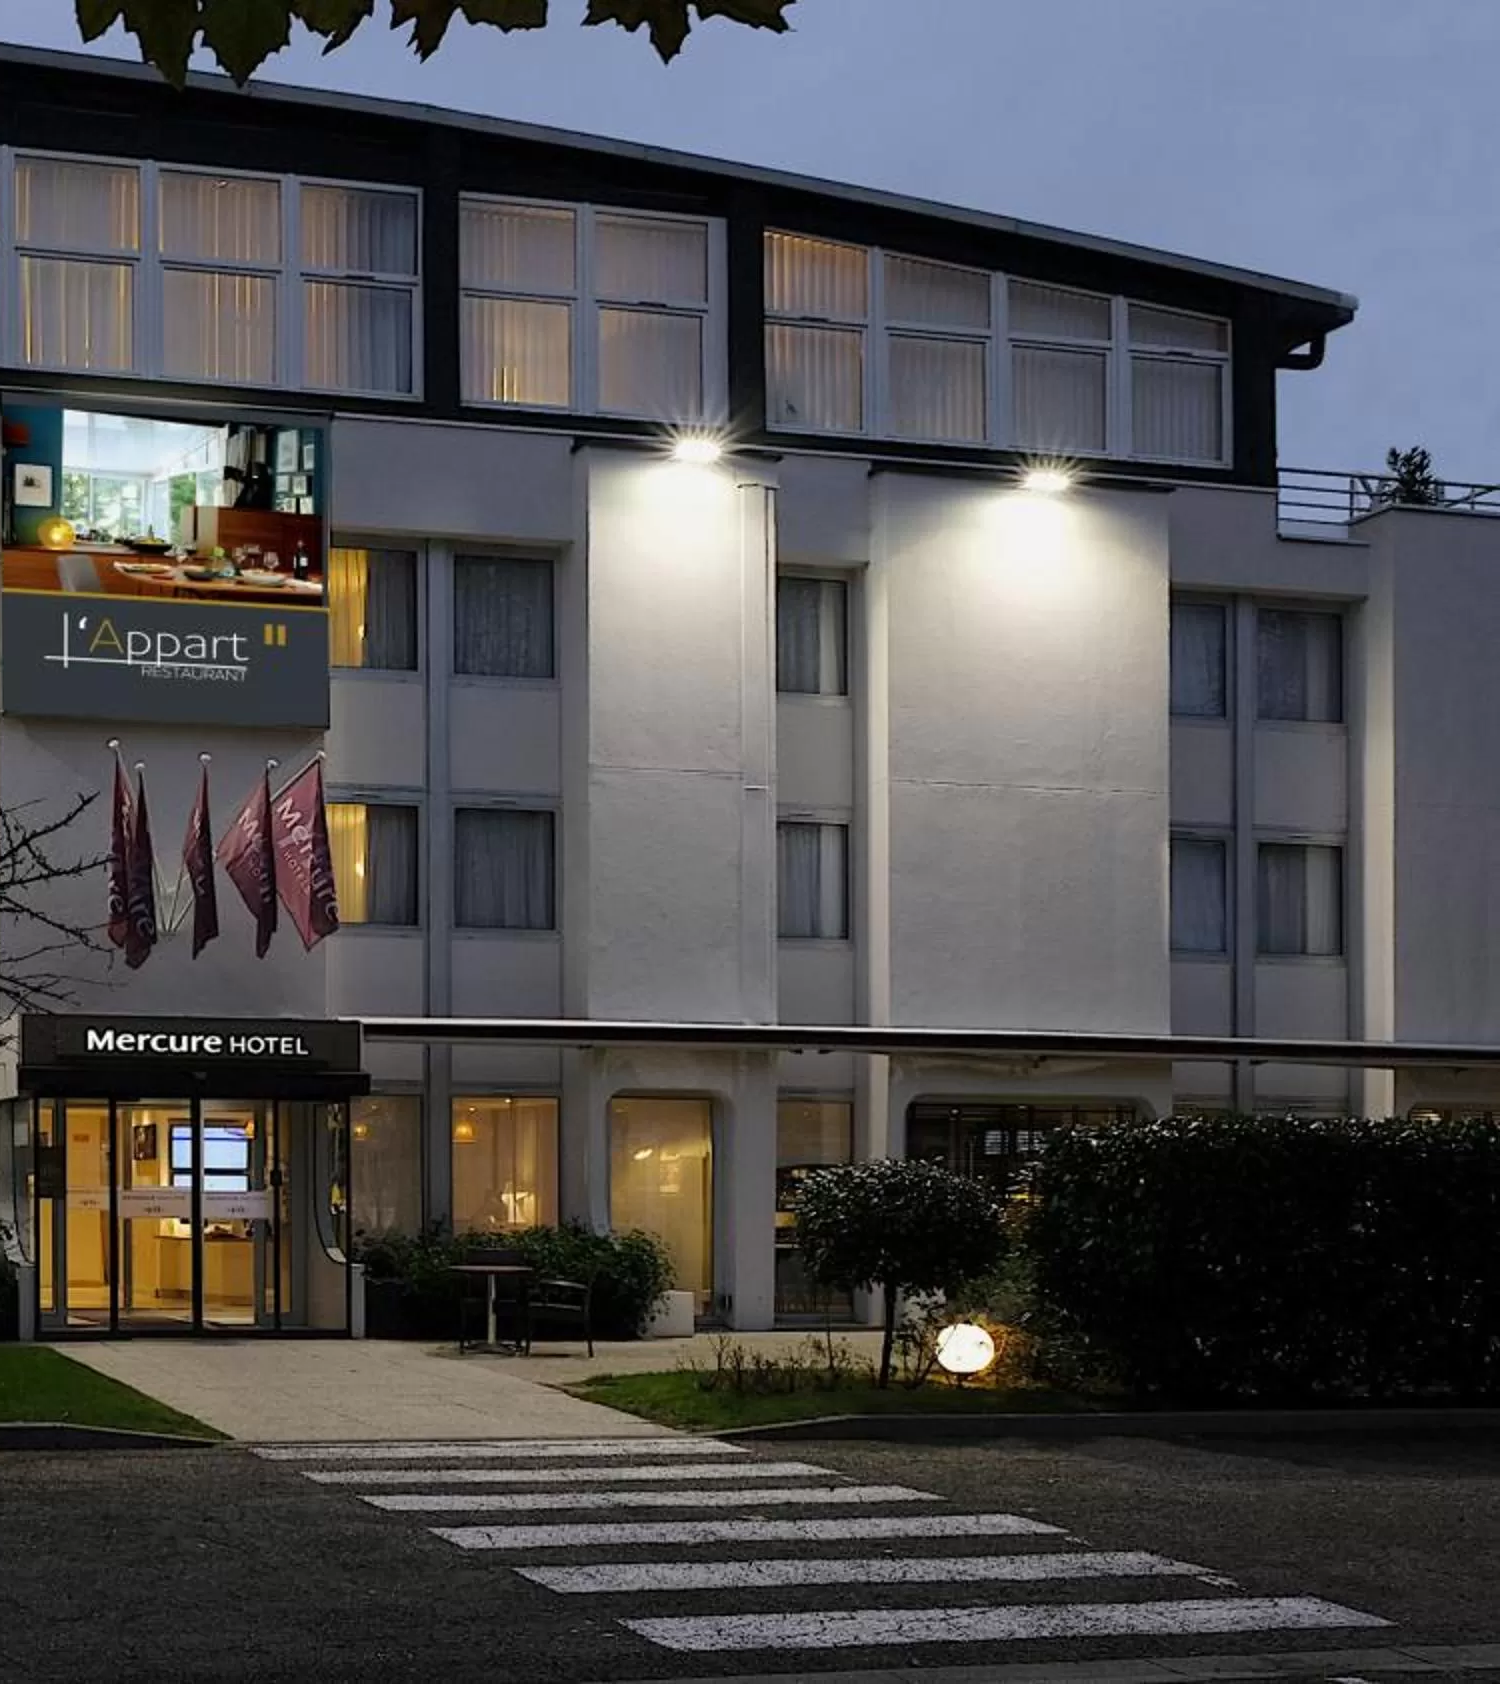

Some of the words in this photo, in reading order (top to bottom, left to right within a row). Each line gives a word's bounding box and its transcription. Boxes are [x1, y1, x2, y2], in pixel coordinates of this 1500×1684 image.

[141, 665, 248, 682] RESTAURANT
[87, 1028, 223, 1054] Mercure
[229, 1035, 309, 1055] HOTEL
